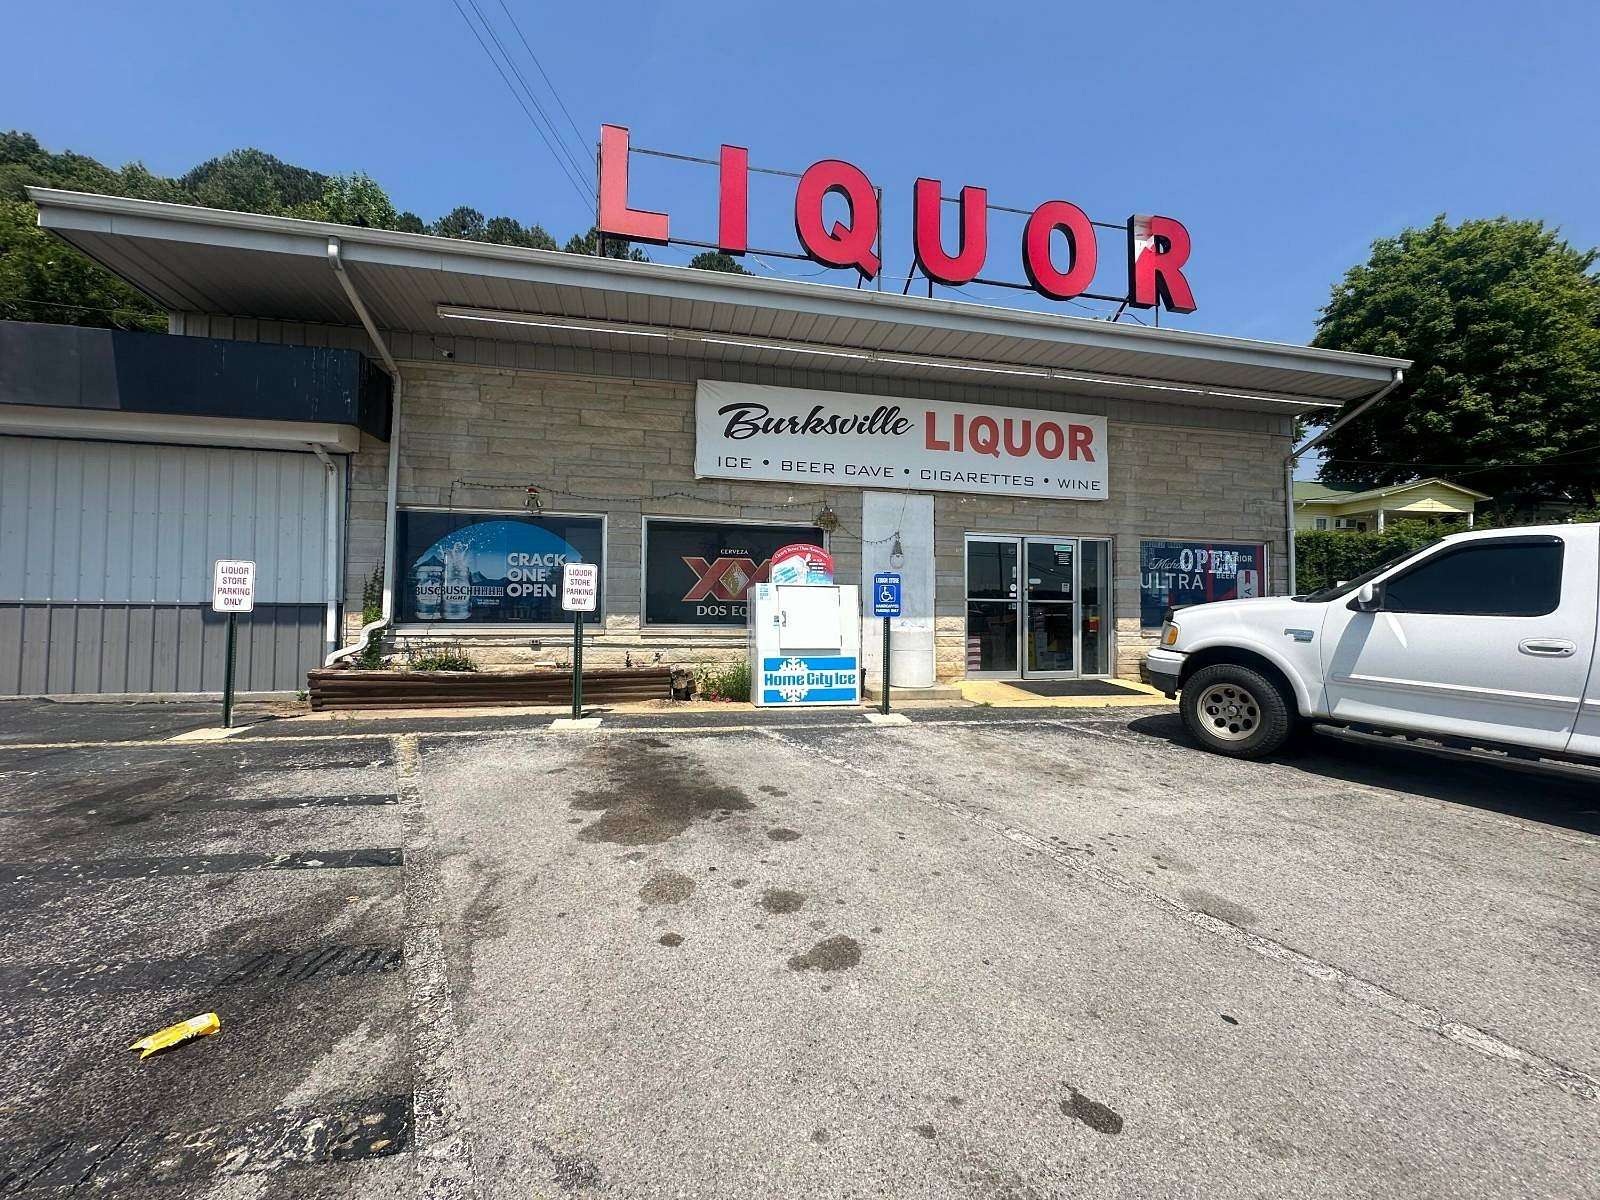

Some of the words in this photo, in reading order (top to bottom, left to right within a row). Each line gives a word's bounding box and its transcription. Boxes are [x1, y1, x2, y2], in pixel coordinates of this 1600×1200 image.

[600, 123, 1197, 313] LIQUOR
[718, 402, 914, 440] Burksville
[925, 411, 1096, 463] LIQUOR
[718, 456, 752, 469] ICE
[781, 460, 835, 474] BEER
[845, 464, 894, 478] CAVE
[920, 469, 1034, 487] CIGARETTES
[1057, 478, 1101, 491] WINE
[507, 552, 567, 567] CRACK
[1180, 548, 1239, 575] OPEN
[221, 566, 249, 575] LIQUOR
[507, 567, 546, 582] ONE
[569, 568, 593, 577] LIQUOR
[222, 576, 247, 585] STORE
[570, 578, 591, 587] STORE
[1140, 572, 1204, 591] ULTRA
[217, 587, 250, 596] PARKING
[506, 583, 557, 598] OPEN
[566, 588, 593, 596] PARKING
[224, 598, 243, 606] ONLY
[571, 597, 587, 605] ONLY
[696, 605, 727, 617] DOS
[764, 673, 804, 686] Home
[806, 672, 833, 688] City
[835, 672, 856, 685] Ice
